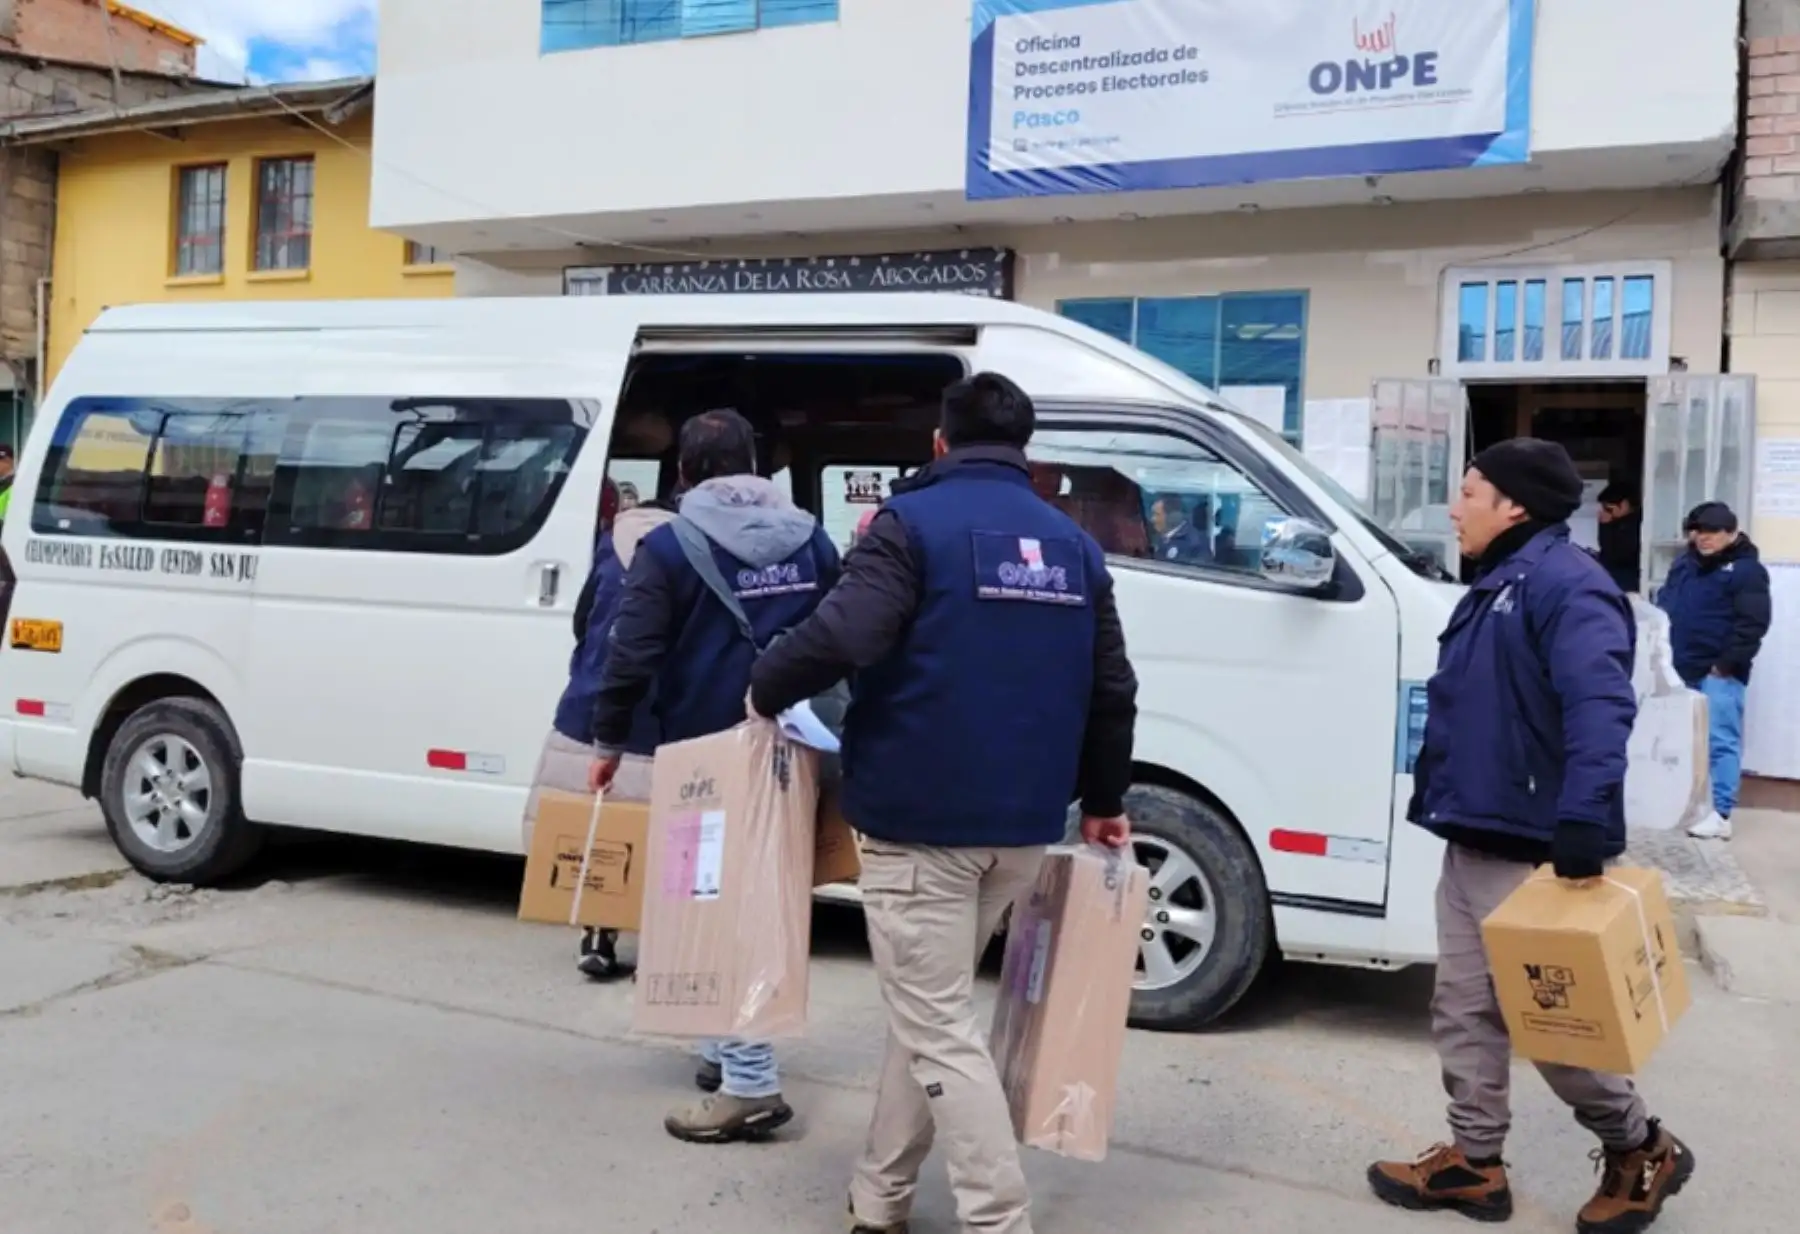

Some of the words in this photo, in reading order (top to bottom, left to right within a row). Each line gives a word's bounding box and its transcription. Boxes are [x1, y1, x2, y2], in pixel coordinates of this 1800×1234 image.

[1015, 34, 1081, 54] Oficina
[1015, 48, 1168, 77] Descentralizada
[1172, 44, 1198, 61] de
[1309, 51, 1438, 95] ONPE
[1014, 81, 1098, 100] Procesos
[1101, 69, 1209, 92] Electorales
[1013, 109, 1081, 129] Pasco
[621, 274, 728, 294] CARRANZA
[796, 268, 852, 289] ROSA
[869, 263, 987, 287] ABOGADOS
[209, 552, 236, 577] SAN
